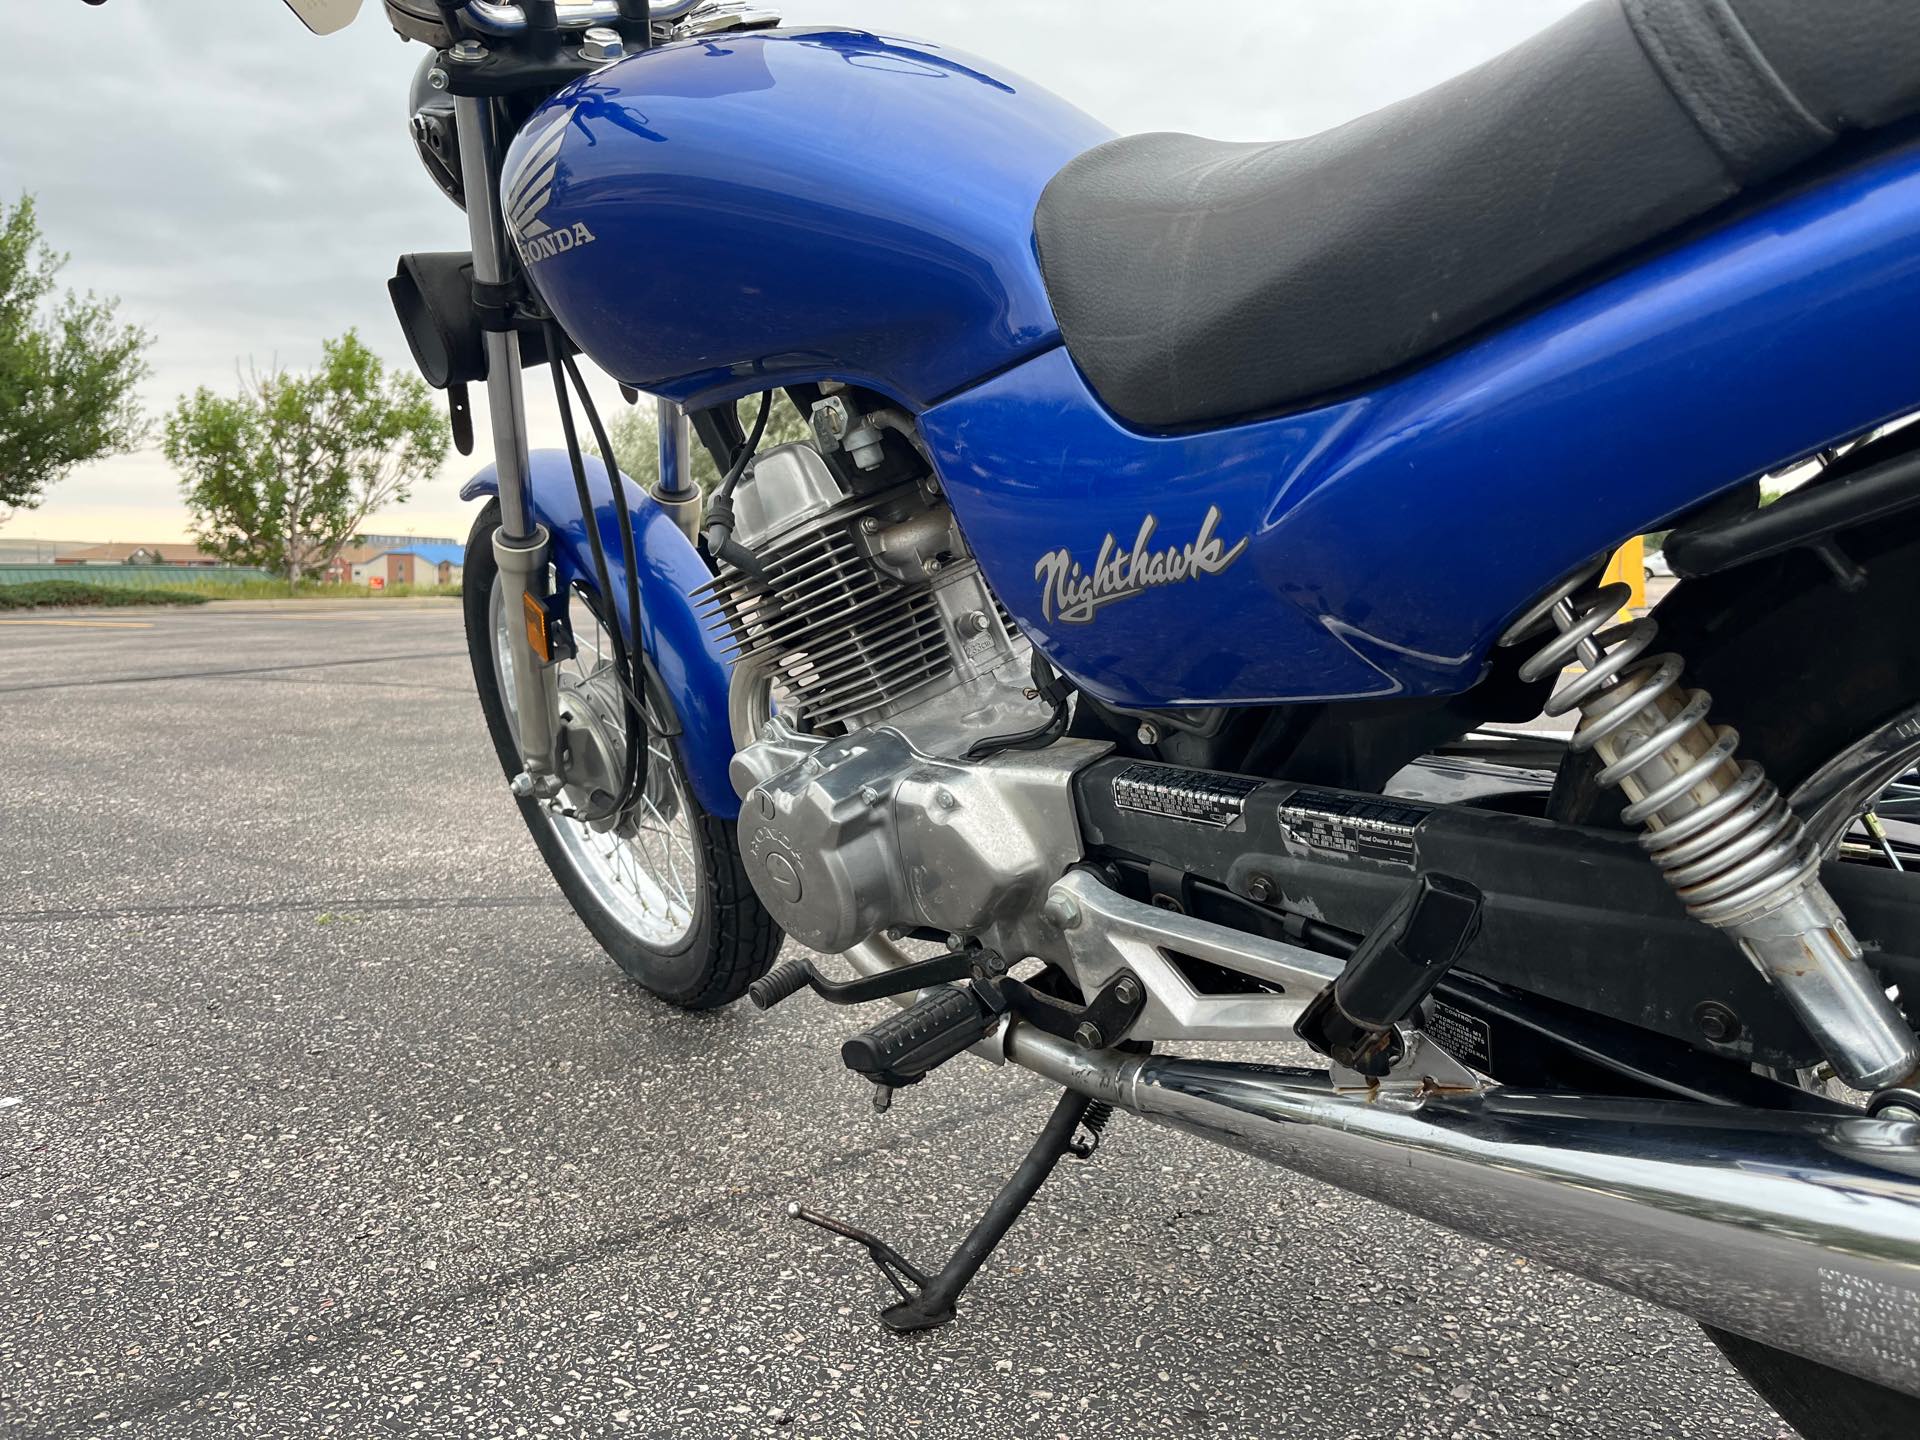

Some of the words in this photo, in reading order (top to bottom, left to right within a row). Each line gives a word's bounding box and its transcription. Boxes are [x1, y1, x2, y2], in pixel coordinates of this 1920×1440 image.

[519, 222, 596, 266] HONDA
[1034, 504, 1250, 624] Nighthawk
[1359, 833, 1372, 842] Read
[1372, 836, 1393, 846] Owner's
[1394, 839, 1413, 849] Manual
[1433, 1013, 1470, 1033] OTORCYCLE
[1444, 1007, 1473, 1024] CONTROL
[1438, 1019, 1486, 1045] REQUIREMENTS
